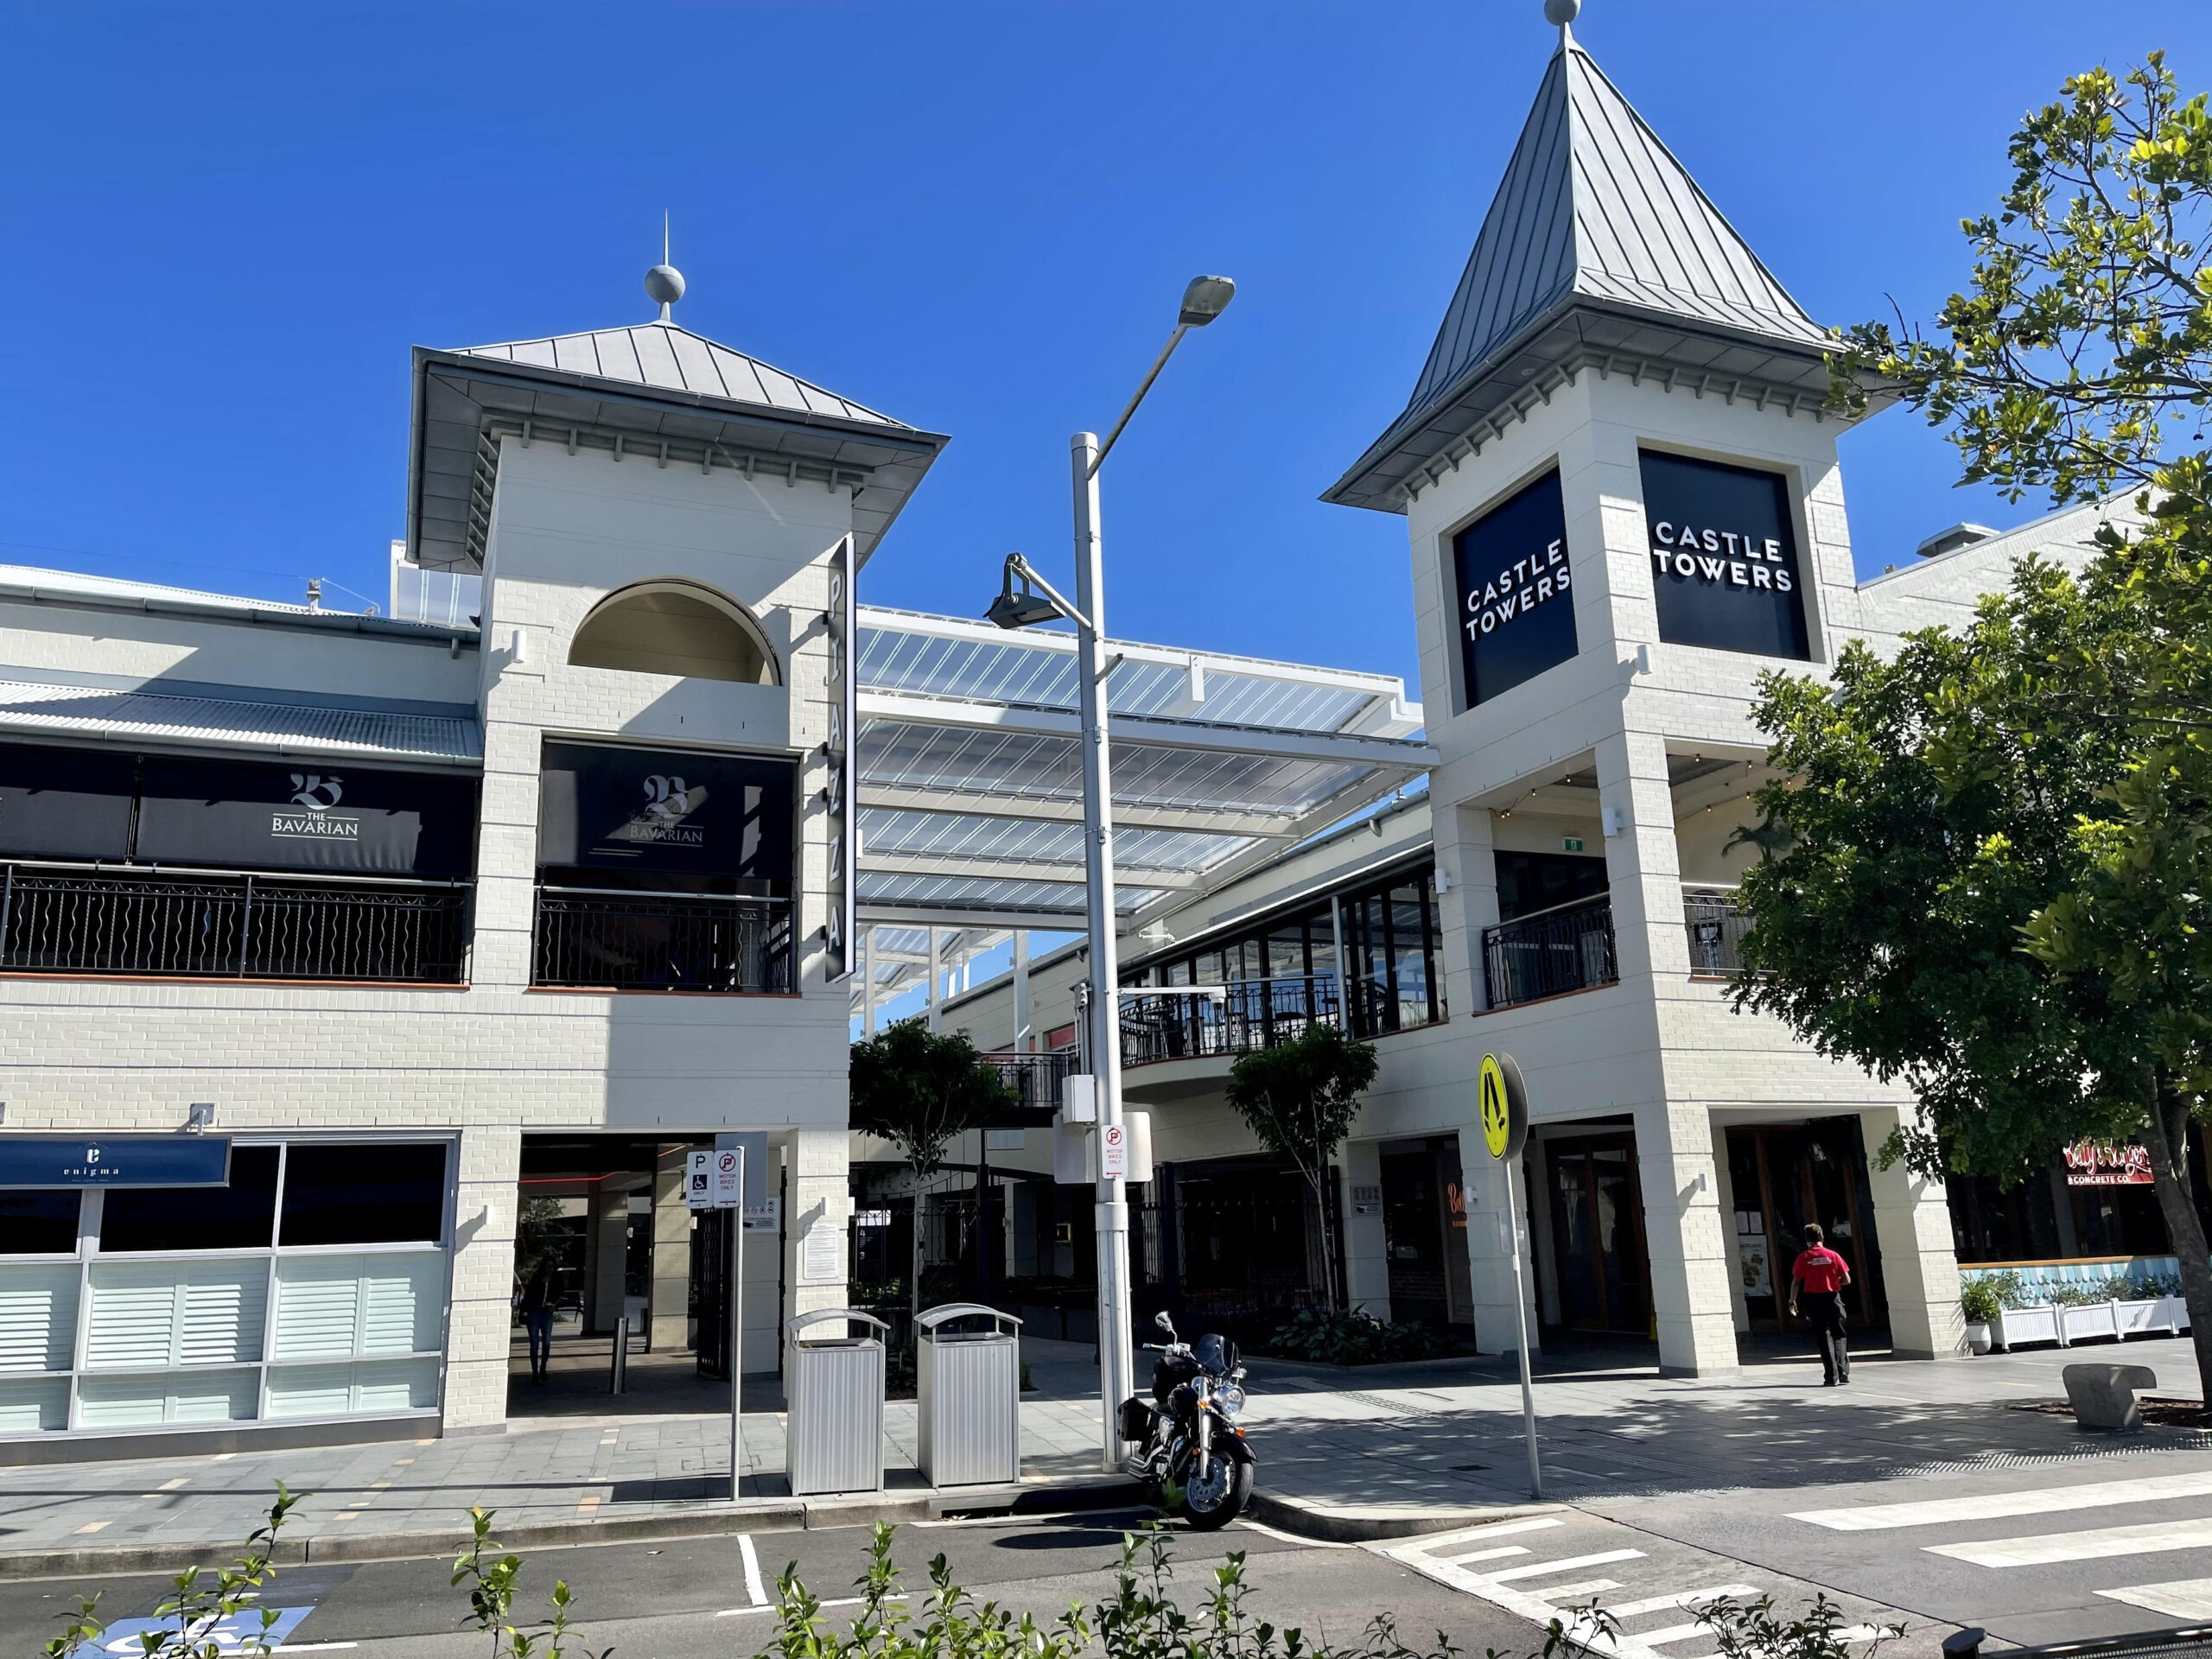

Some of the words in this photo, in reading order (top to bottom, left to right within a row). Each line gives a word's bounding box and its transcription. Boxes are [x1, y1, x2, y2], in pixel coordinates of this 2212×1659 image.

[1655, 521, 1783, 563] CASTLE
[1468, 538, 1563, 613] CASTLE
[1653, 549, 1792, 592] TOWERS
[1465, 566, 1571, 641] TOWERS
[828, 574, 842, 952] PIAZZA
[307, 812, 326, 821] THE
[272, 817, 359, 836] BAVARIAN
[630, 825, 703, 842] BAVARIAN
[696, 1155, 706, 1169] P
[63, 1166, 119, 1177] enigma
[2075, 1175, 2116, 1185] CONCRETE
[859, 1229, 866, 1237] 4
[859, 1251, 866, 1260] 3
